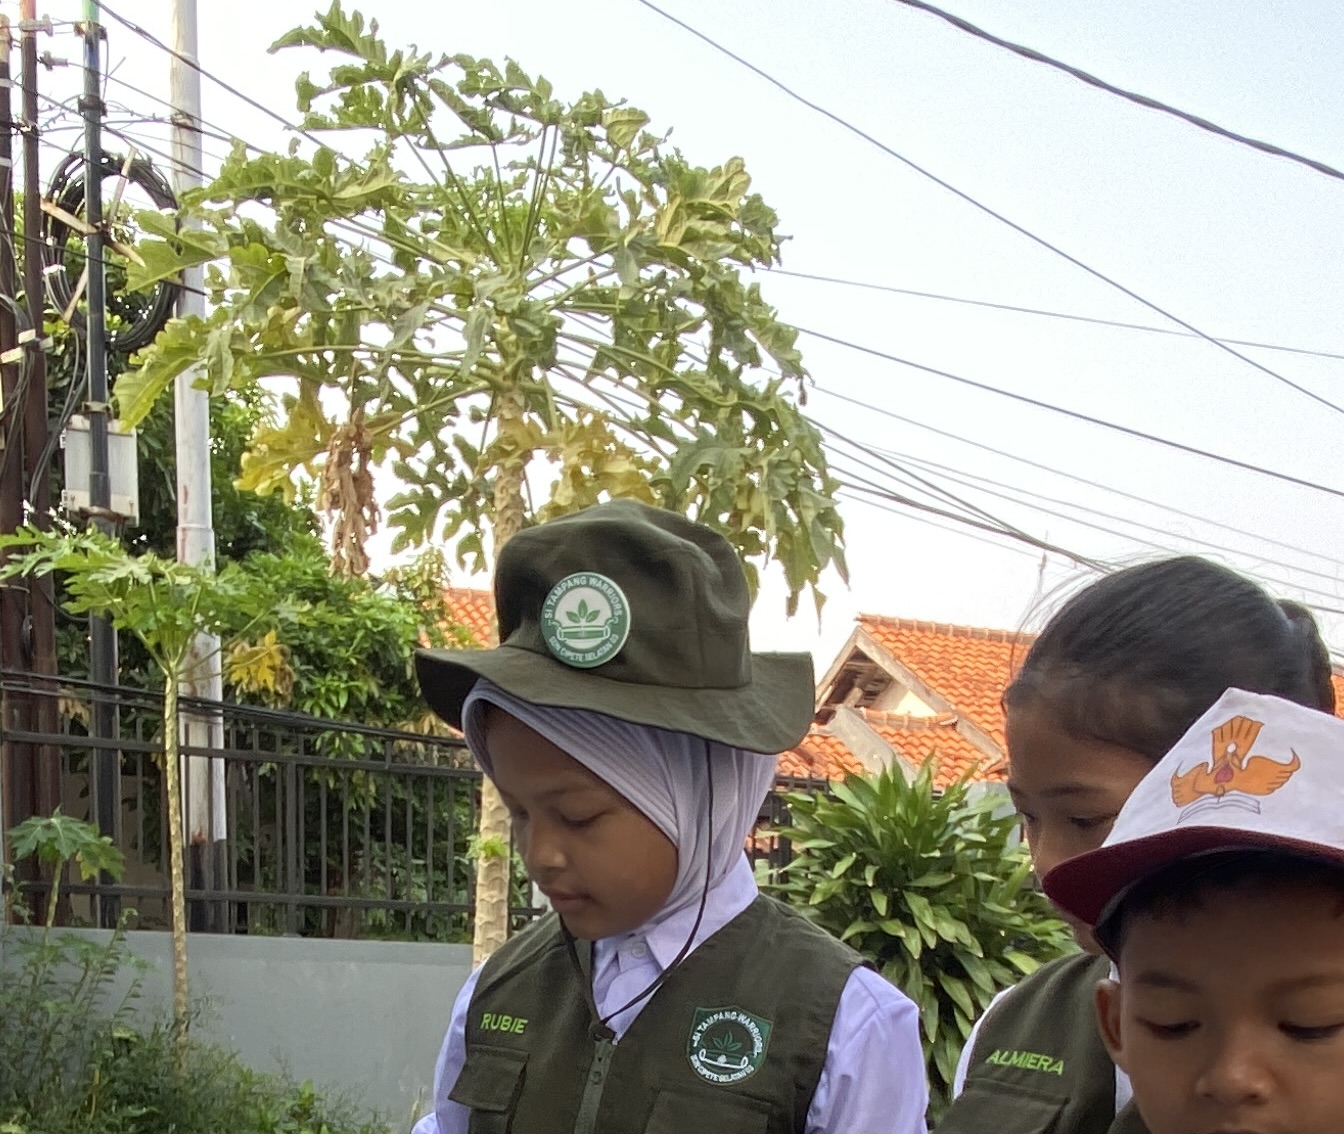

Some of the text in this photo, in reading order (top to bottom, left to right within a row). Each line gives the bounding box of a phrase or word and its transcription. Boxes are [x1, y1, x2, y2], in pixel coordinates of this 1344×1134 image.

[544, 576, 623, 619] SI TAMPANG WARRIORS
[560, 647, 584, 662] CIPETE
[585, 643, 613, 662] SELATAN
[480, 1013, 528, 1034] RUBIE
[697, 1011, 737, 1032] TAMPANG
[985, 1049, 1064, 1076] ALMIERA
